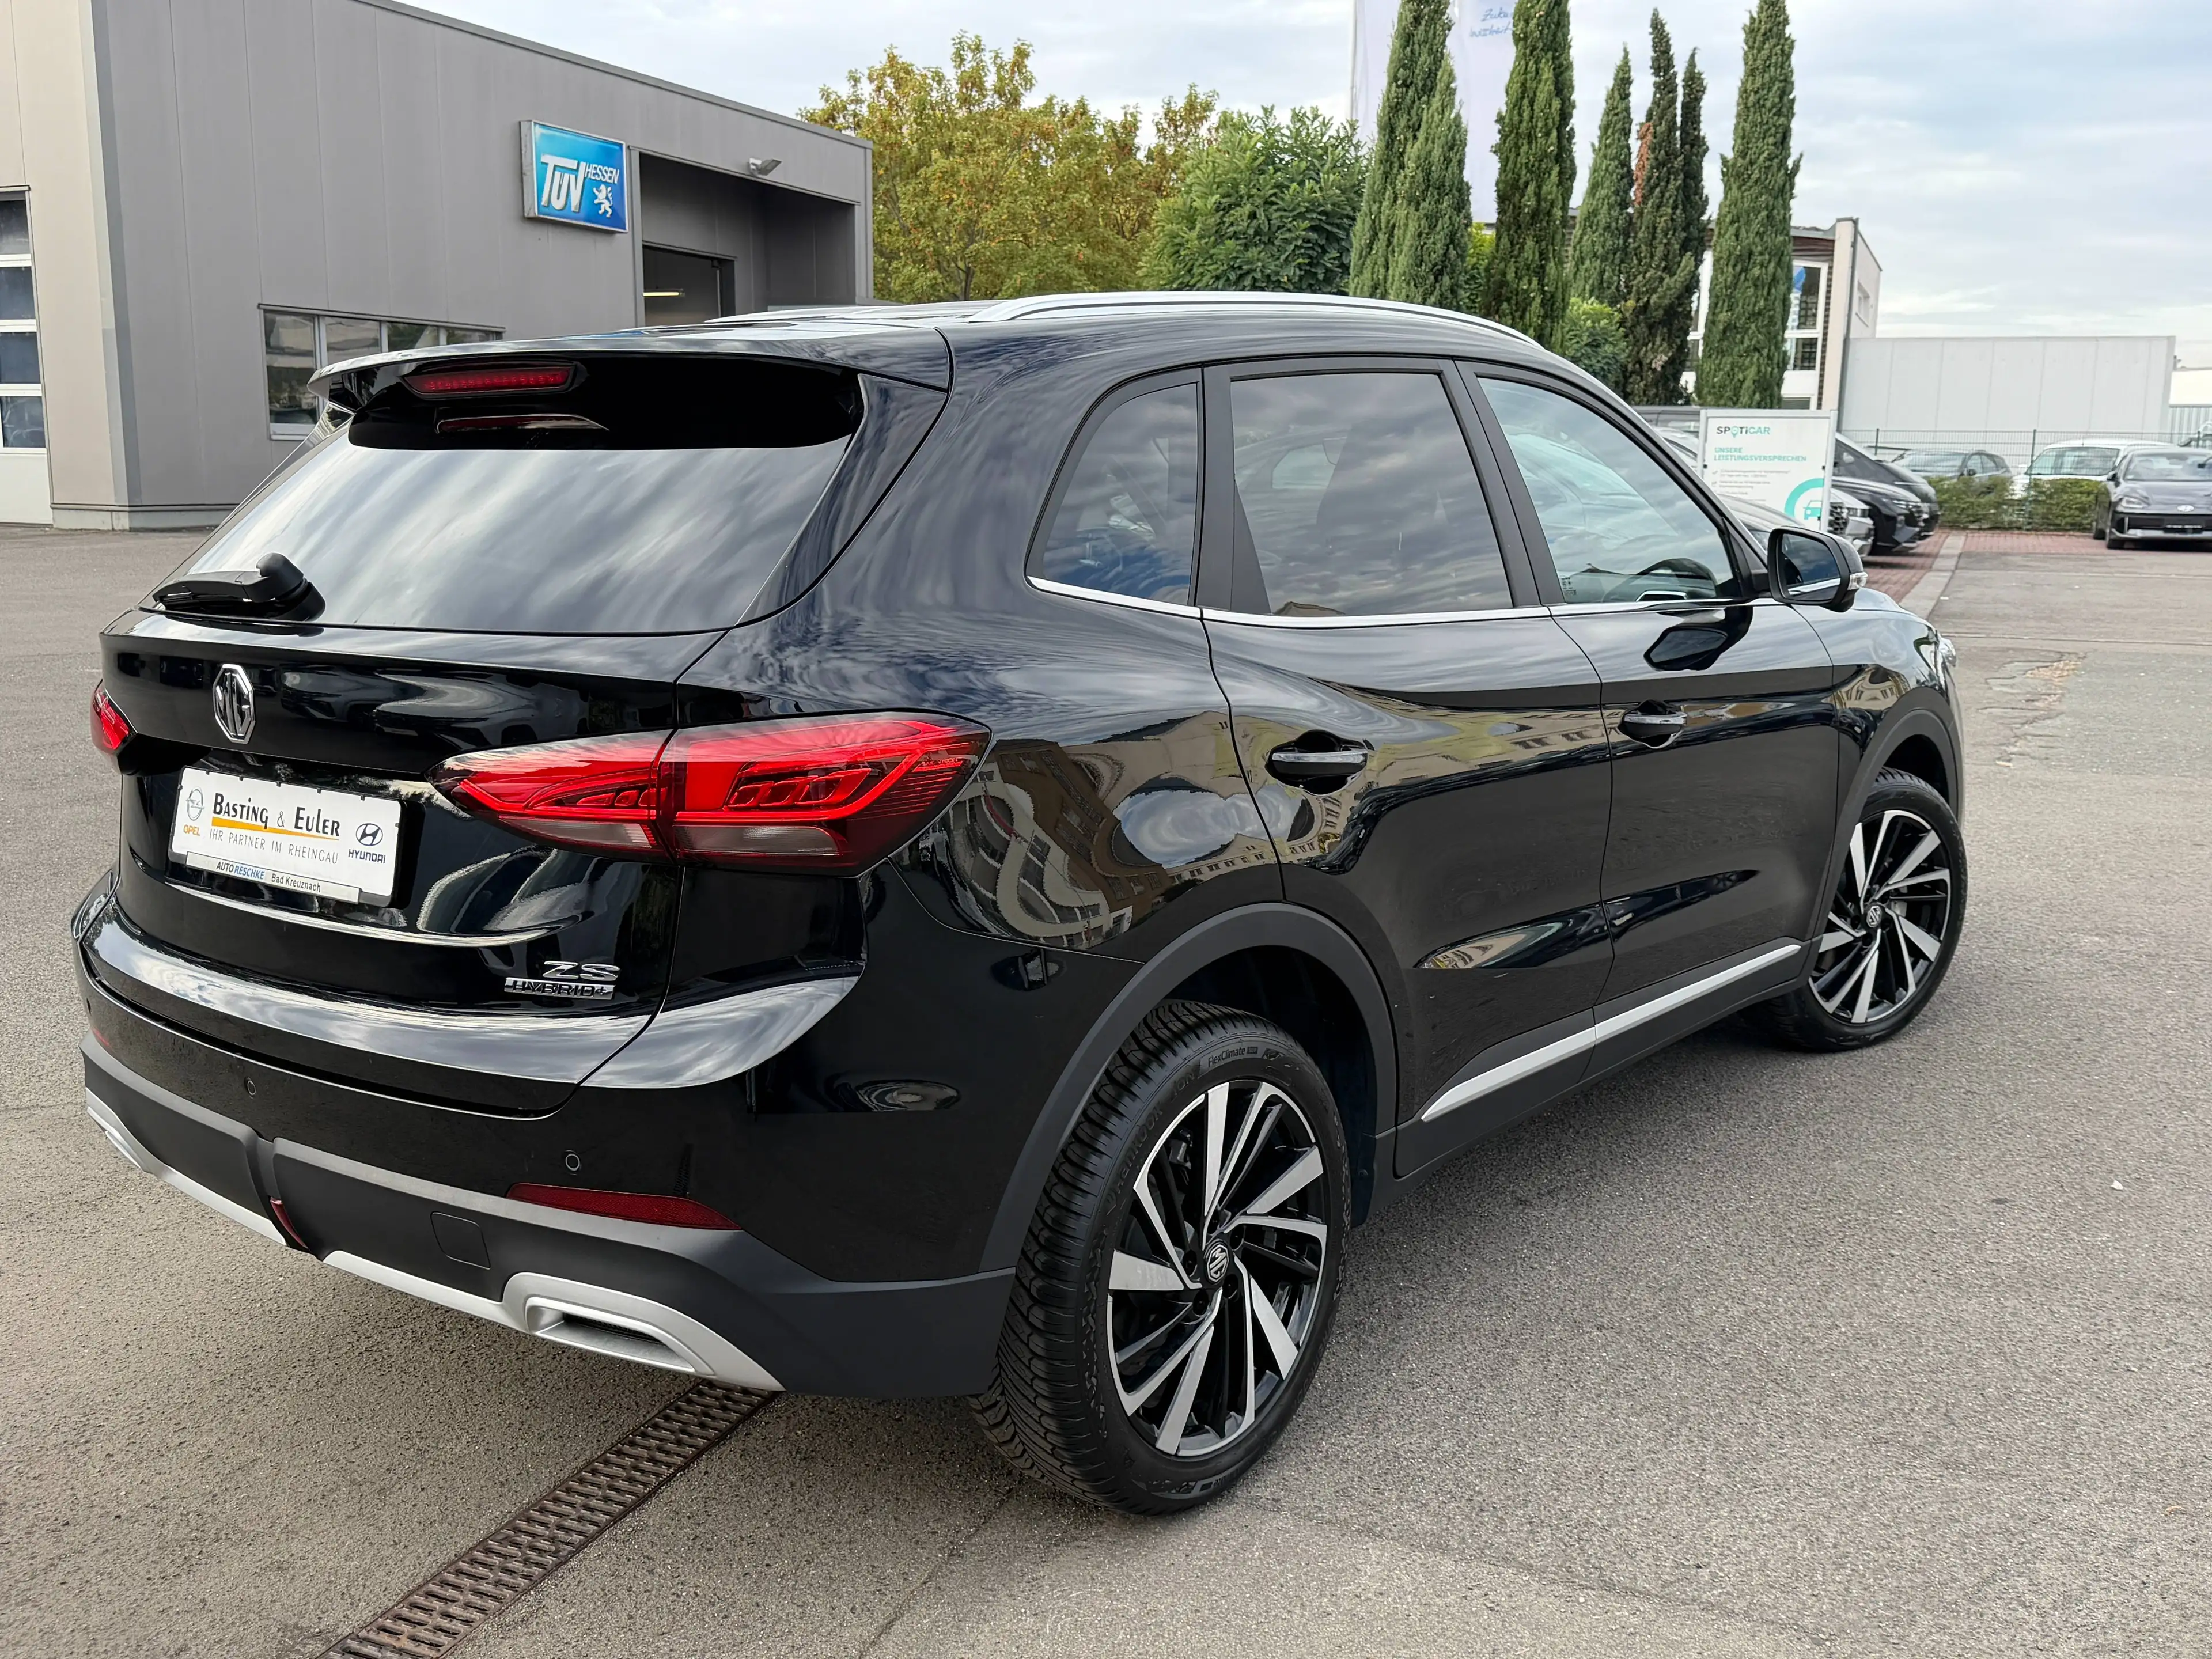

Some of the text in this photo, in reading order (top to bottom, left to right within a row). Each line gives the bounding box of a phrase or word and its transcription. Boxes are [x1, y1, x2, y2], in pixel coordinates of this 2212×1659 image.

[585, 162, 620, 184] HESSEN
[214, 668, 253, 740] MG
[183, 824, 200, 836] OPEL
[277, 811, 285, 828] &
[210, 828, 338, 864] IHR PARTNER IM RHEINGAU
[348, 849, 386, 863] HYUNDAI
[216, 861, 321, 892] AUTO RESCHKE Bad Kreuznach
[543, 960, 620, 981] ZS
[510, 979, 608, 998] HYBRID+
[1208, 1046, 1246, 1067] FlexClimate
[1209, 1246, 1228, 1280] MG
